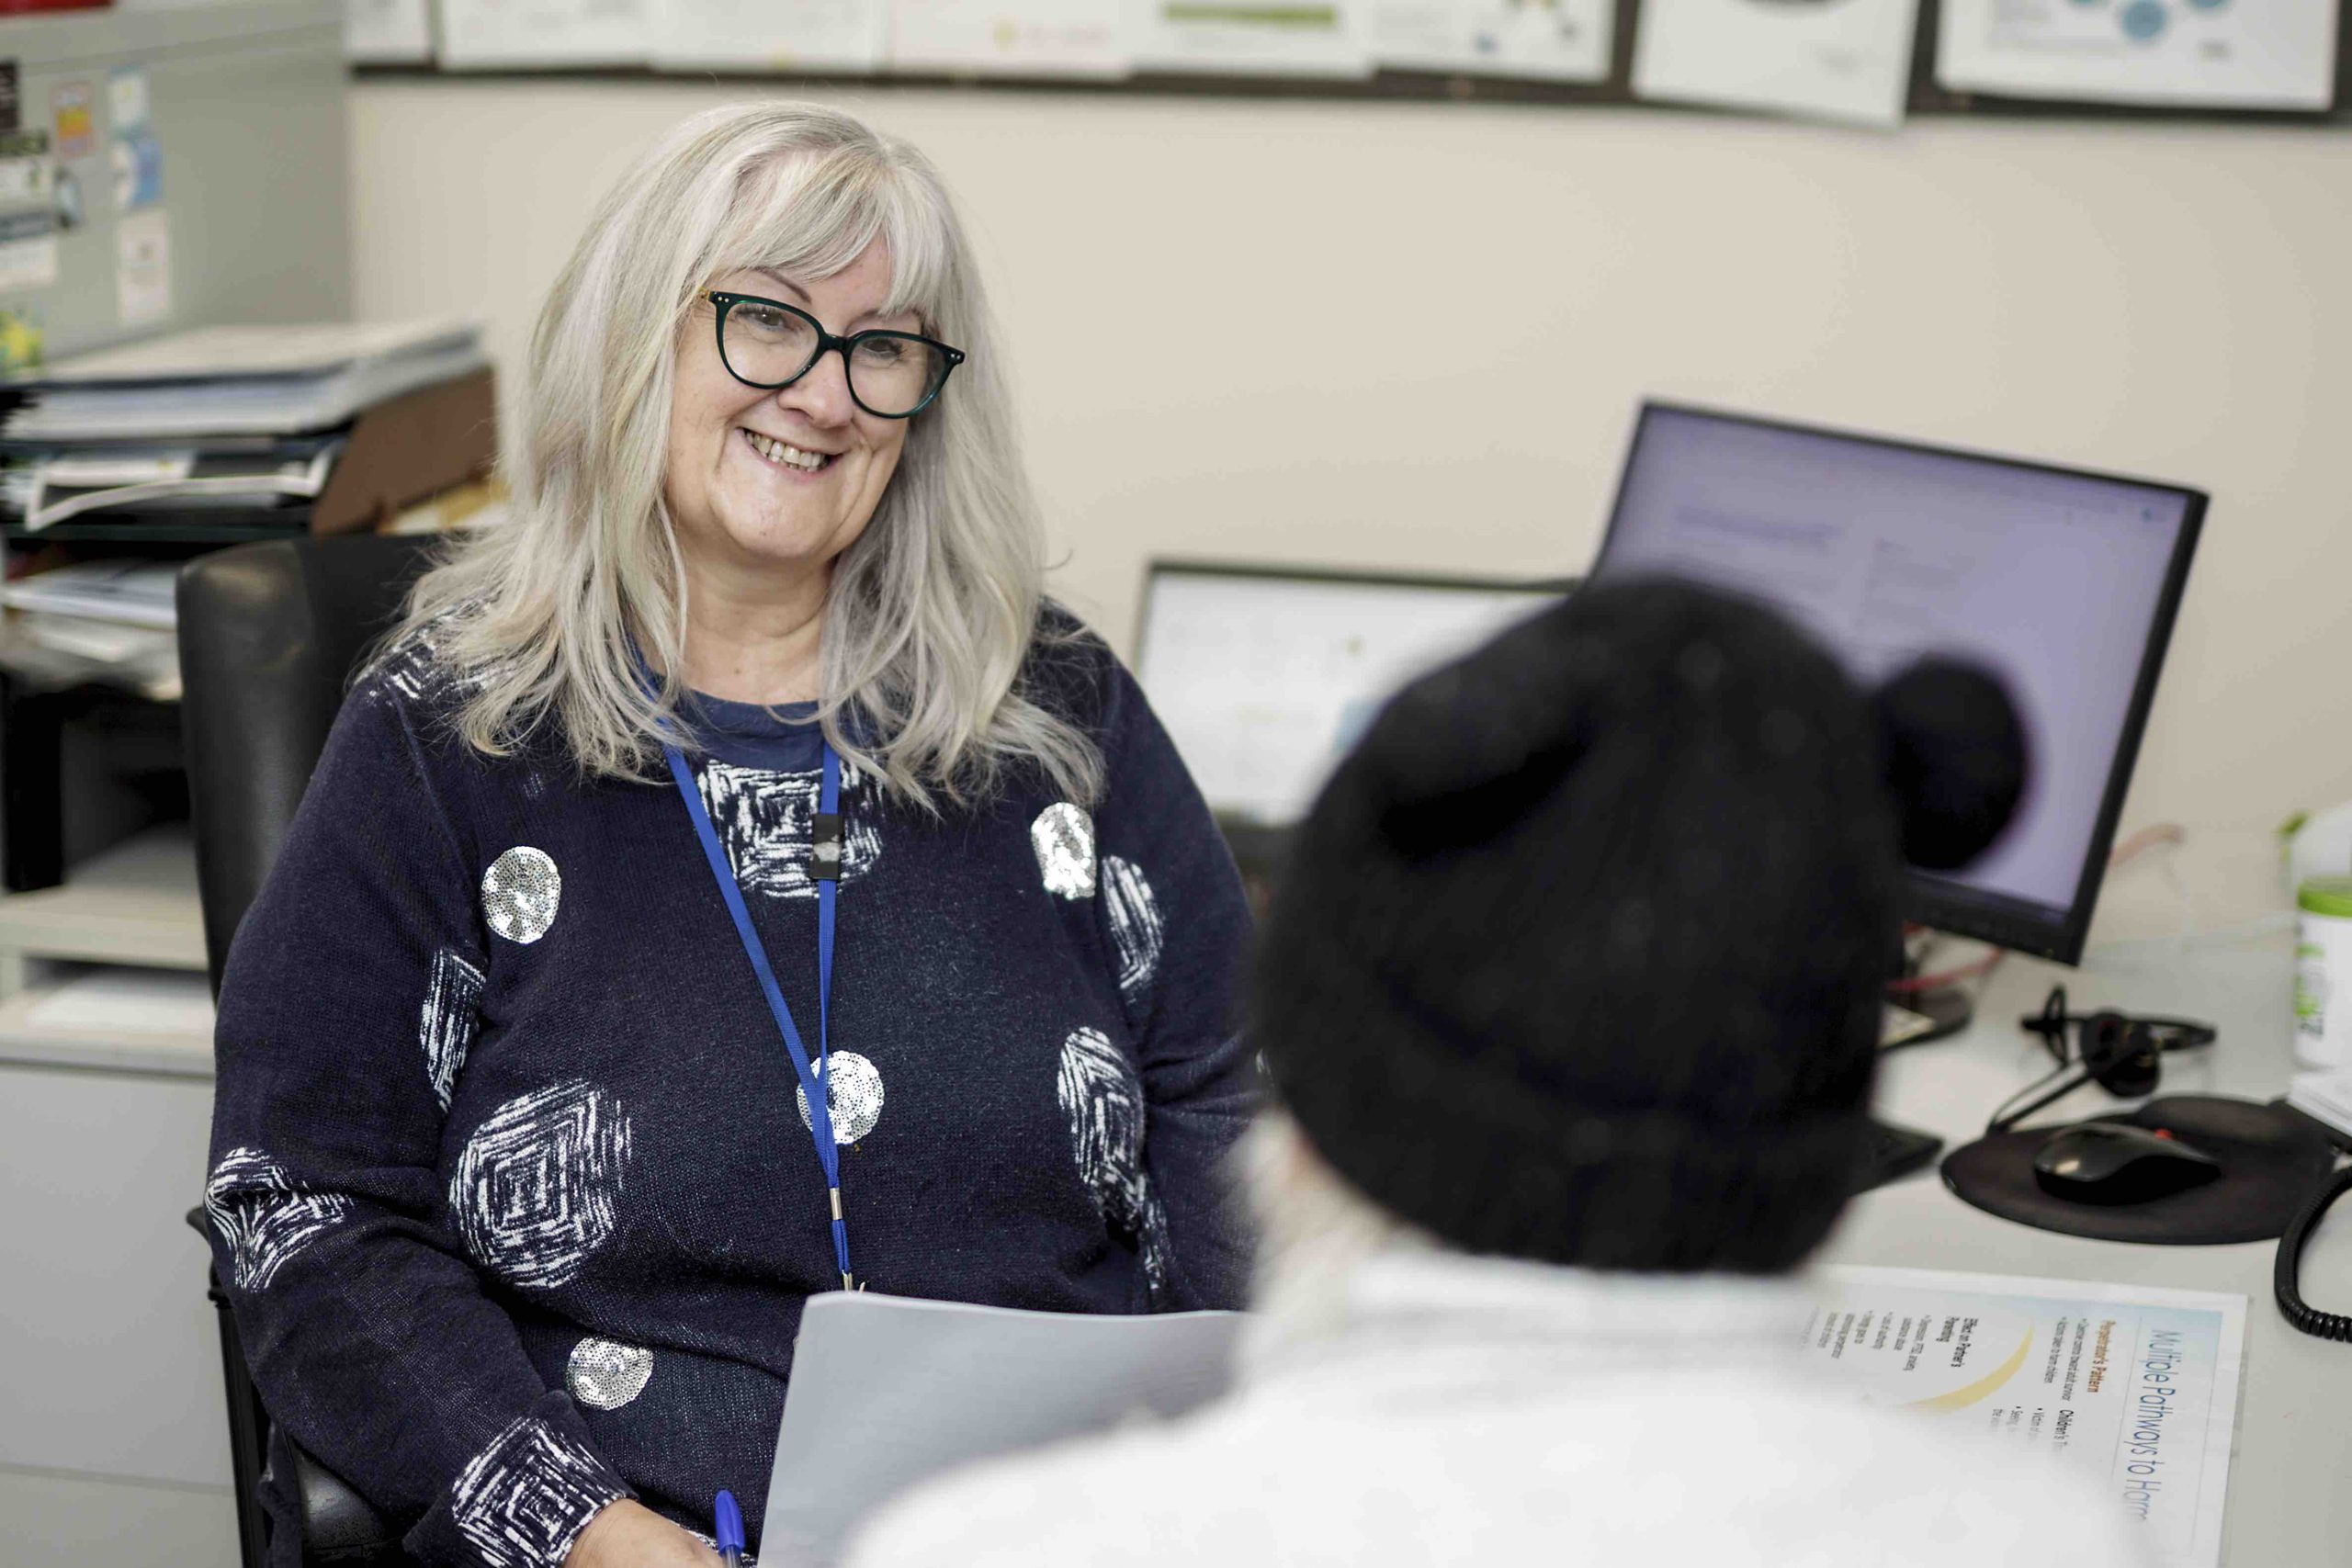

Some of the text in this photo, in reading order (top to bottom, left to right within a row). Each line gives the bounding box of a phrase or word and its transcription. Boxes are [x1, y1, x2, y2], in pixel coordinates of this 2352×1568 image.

[1951, 1343, 1971, 1367] Partner's
[2087, 1320, 2116, 1393] Perpetrator's Pattern
[2139, 1329, 2182, 1382] Multiple
[2053, 1409, 2074, 1440] Children's
[2124, 1386, 2176, 1455] Pathways
[2127, 1460, 2165, 1475] to
